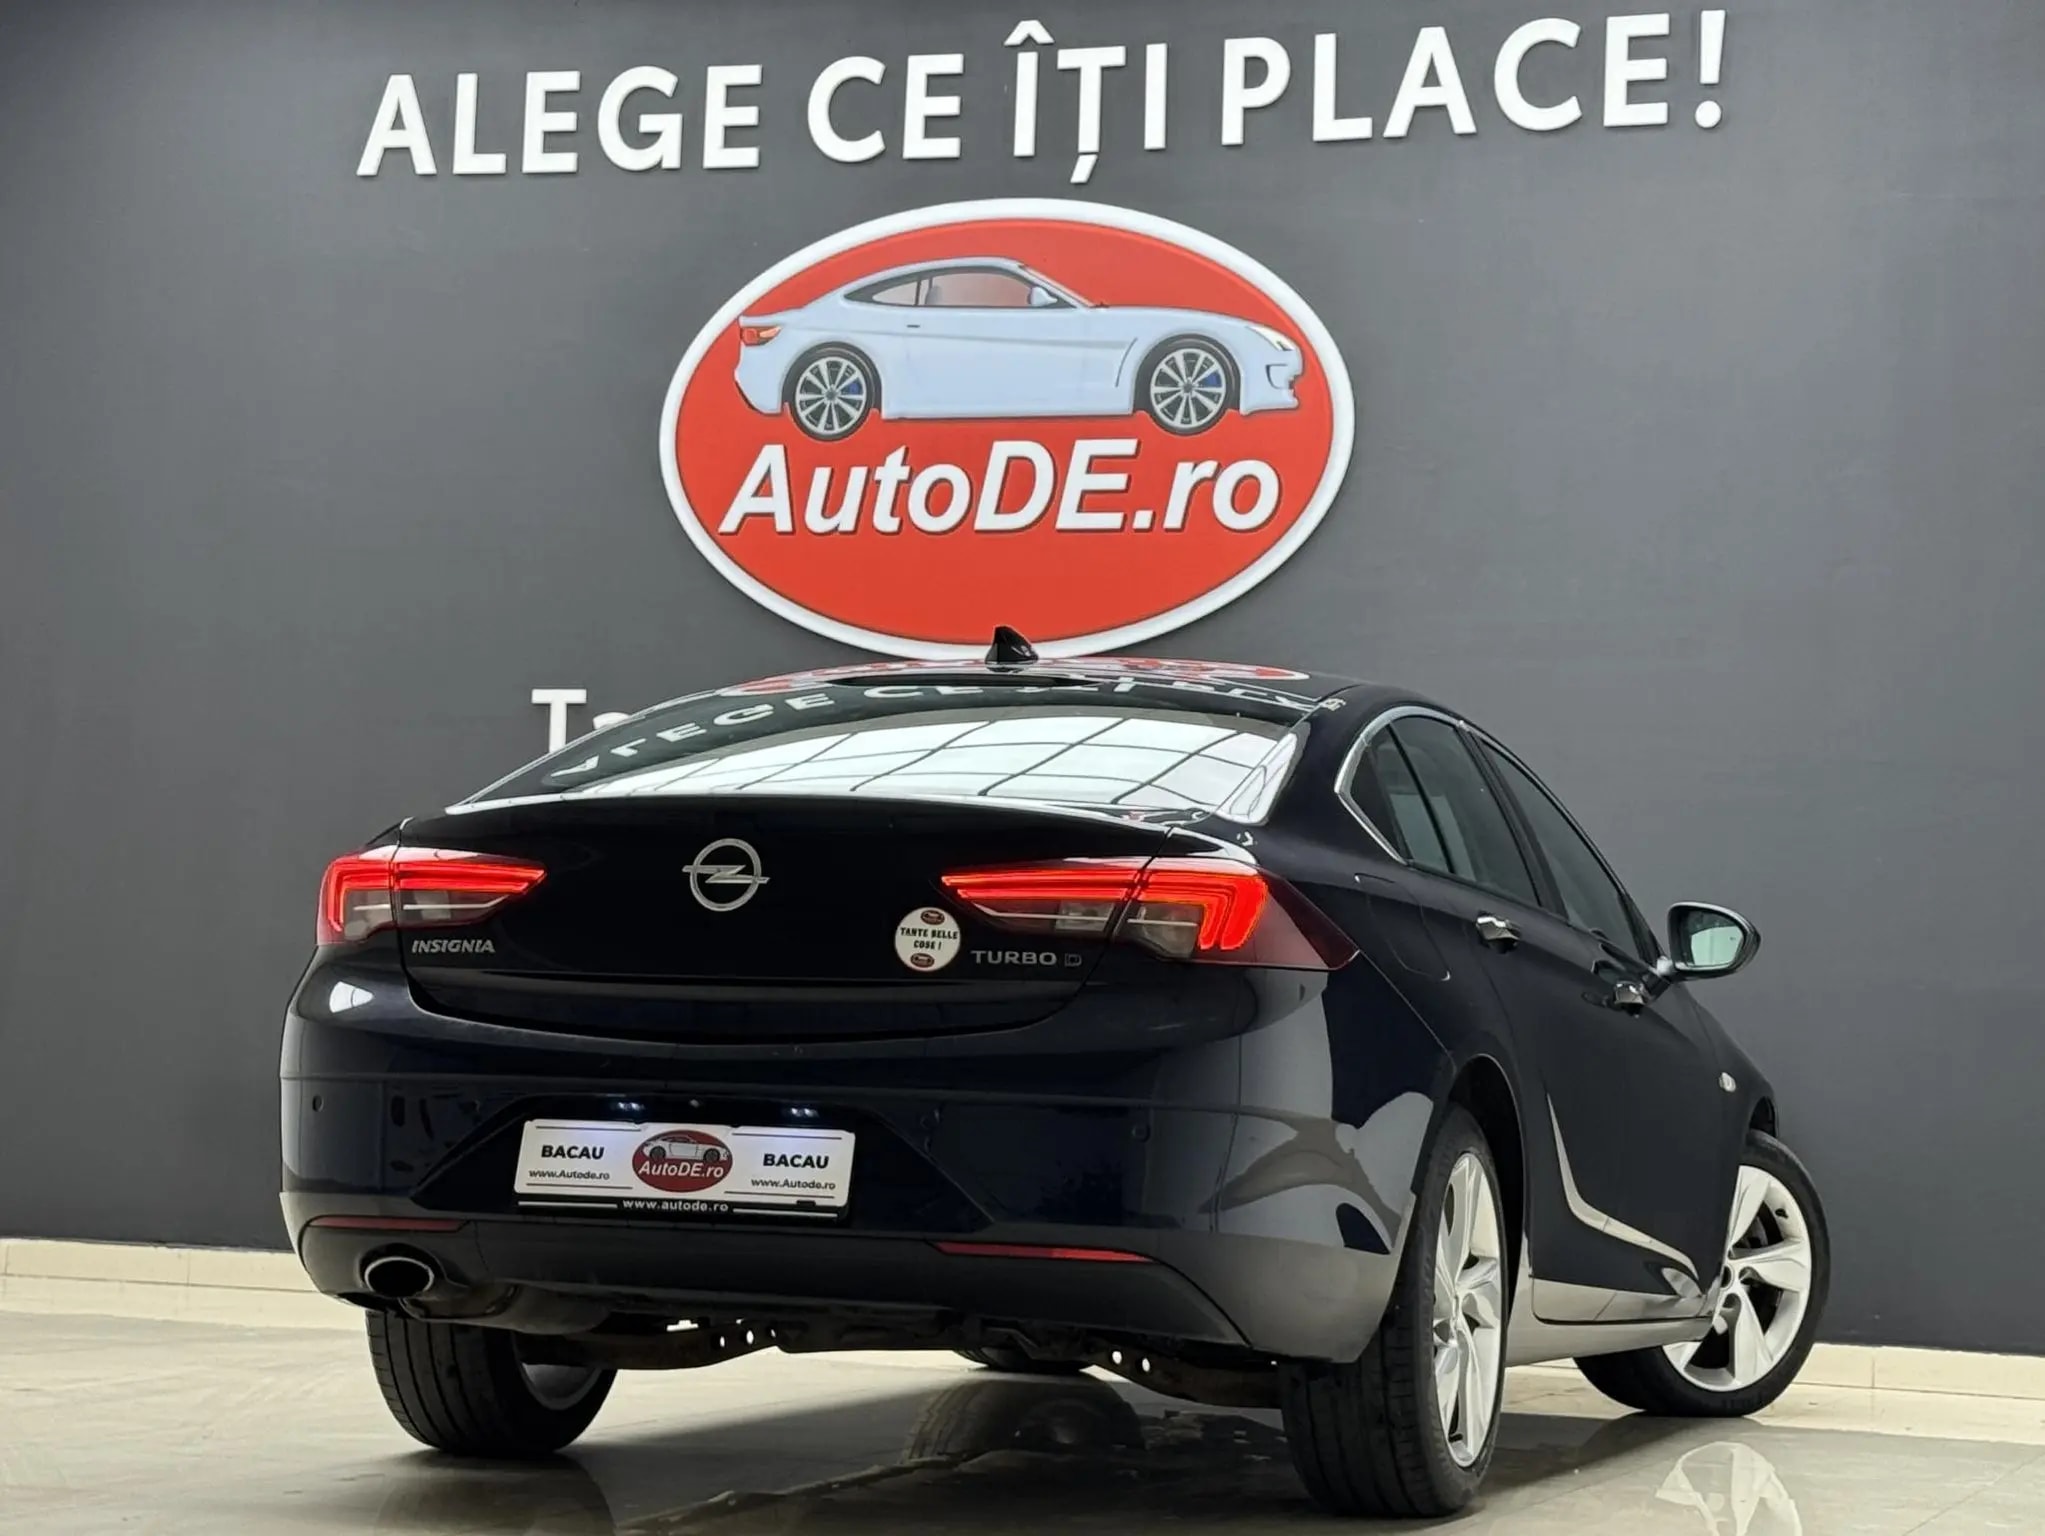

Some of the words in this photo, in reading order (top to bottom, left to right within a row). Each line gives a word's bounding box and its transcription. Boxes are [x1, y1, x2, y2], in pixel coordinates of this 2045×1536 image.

[356, 63, 764, 177] ALEGE
[805, 53, 965, 163] CE
[1221, 9, 1728, 147] PLACE!
[717, 437, 1281, 536] AutoDE.ro
[530, 688, 632, 754] T
[900, 927, 929, 938] TANTE
[931, 929, 959, 940] BELLE
[411, 939, 496, 954] INSIGNIA
[913, 940, 936, 950] COSE
[970, 950, 1058, 966] TURBO
[540, 1144, 606, 1161] BACAU
[762, 1153, 830, 1170] BACAU
[528, 1168, 611, 1182] www.Autode.ro
[638, 1160, 725, 1180] AutoDE.ro
[750, 1177, 837, 1191] www.Autode.ro
[622, 1199, 730, 1213] www.autode.ro
